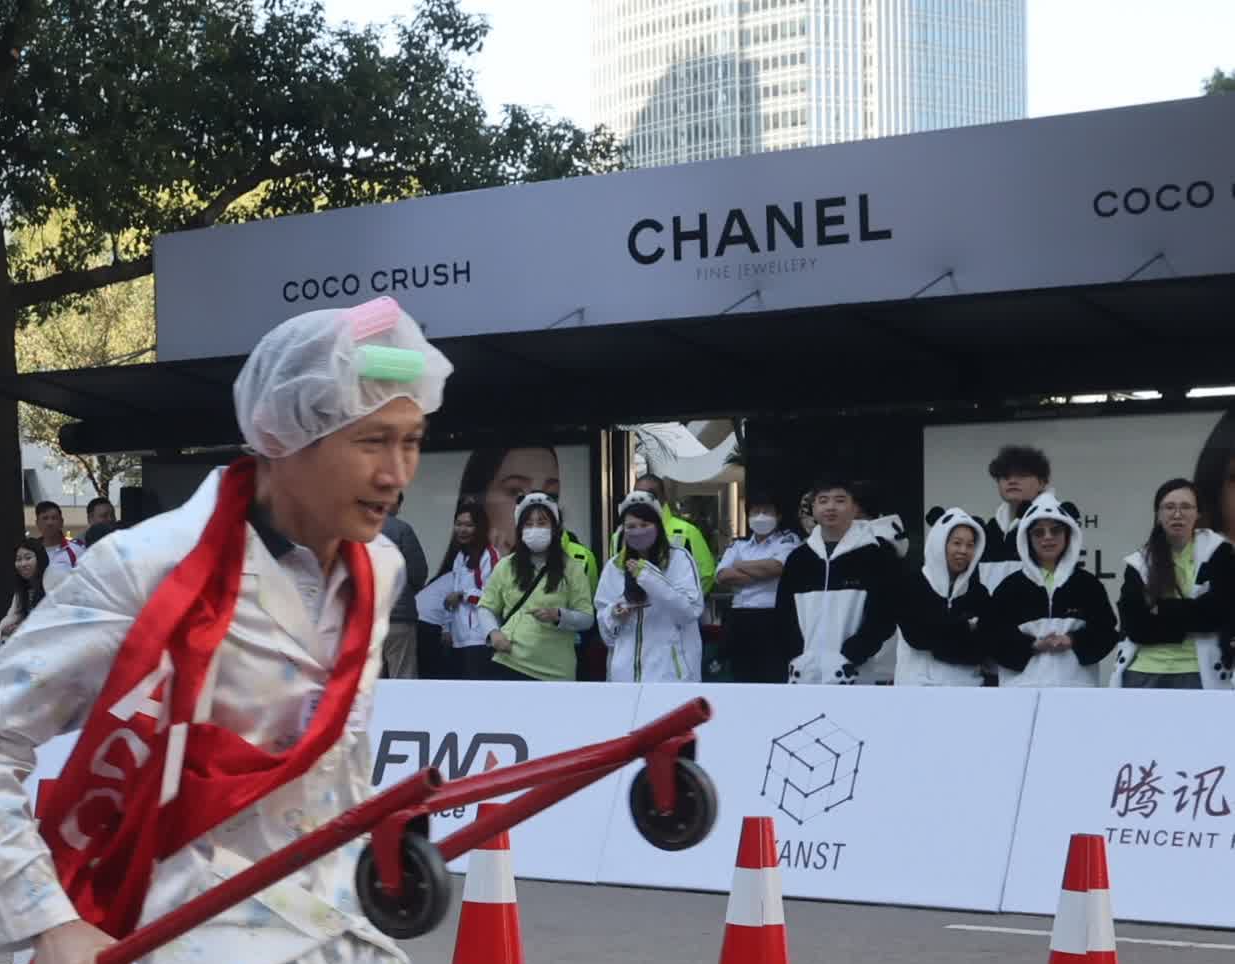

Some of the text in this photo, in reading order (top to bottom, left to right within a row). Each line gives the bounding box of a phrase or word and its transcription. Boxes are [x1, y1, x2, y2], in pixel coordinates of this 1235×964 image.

[1093, 180, 1215, 218] COCO
[627, 193, 893, 266] CHANEL
[282, 260, 472, 303] COCO CRUSH
[695, 257, 818, 281] FINE JEWELLERY
[1109, 760, 1231, 821] 腾讯
[775, 839, 847, 871] ANST
[1105, 827, 1221, 849] TENCENT
